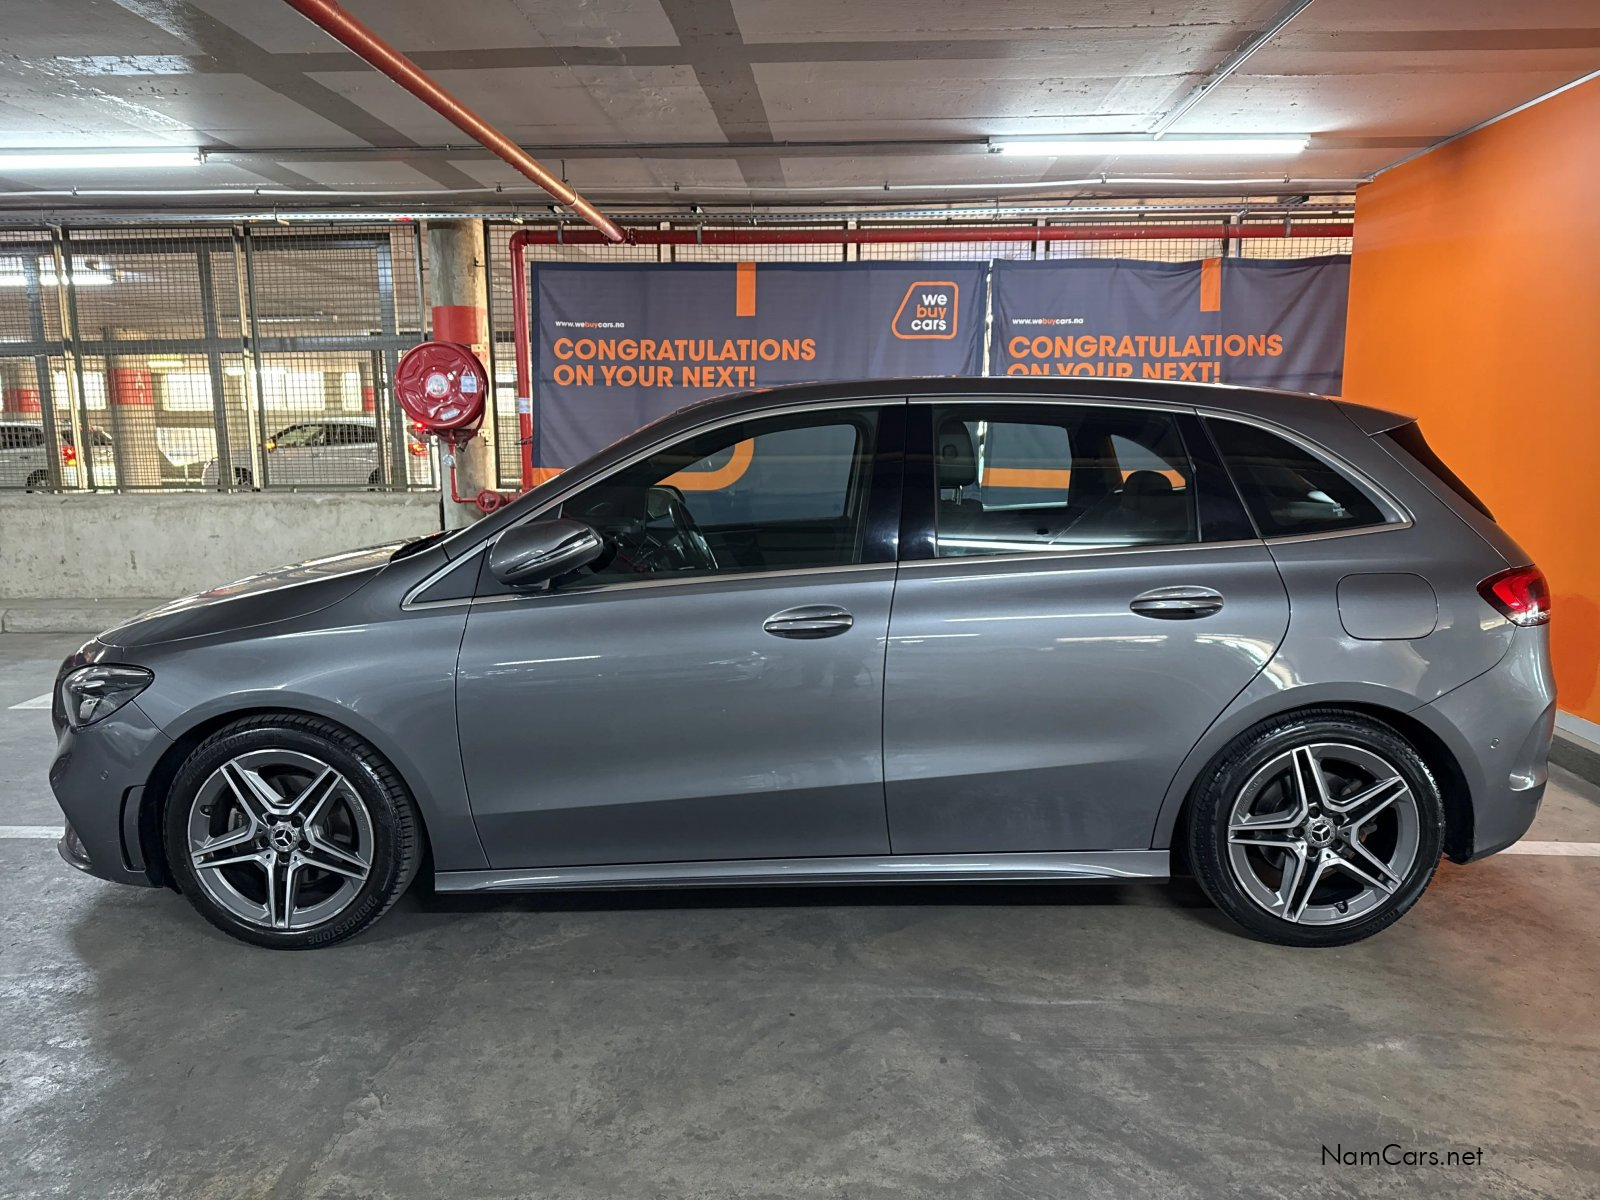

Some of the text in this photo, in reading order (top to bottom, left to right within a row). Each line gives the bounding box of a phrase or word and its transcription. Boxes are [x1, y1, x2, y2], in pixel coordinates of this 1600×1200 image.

[921, 294, 948, 306] we
[916, 304, 947, 320] buy
[1011, 317, 1085, 326] www.webuycars.na
[555, 320, 626, 330] www.webuycars.na
[910, 319, 947, 331] cars
[553, 337, 817, 362] CONGRATULATIONS
[1008, 334, 1284, 359] CONGRATULATIONS
[553, 364, 757, 389] ON YOUR NEXT!
[1142, 361, 1221, 384] NEXT!
[307, 893, 379, 945] BRIDGESTONE
